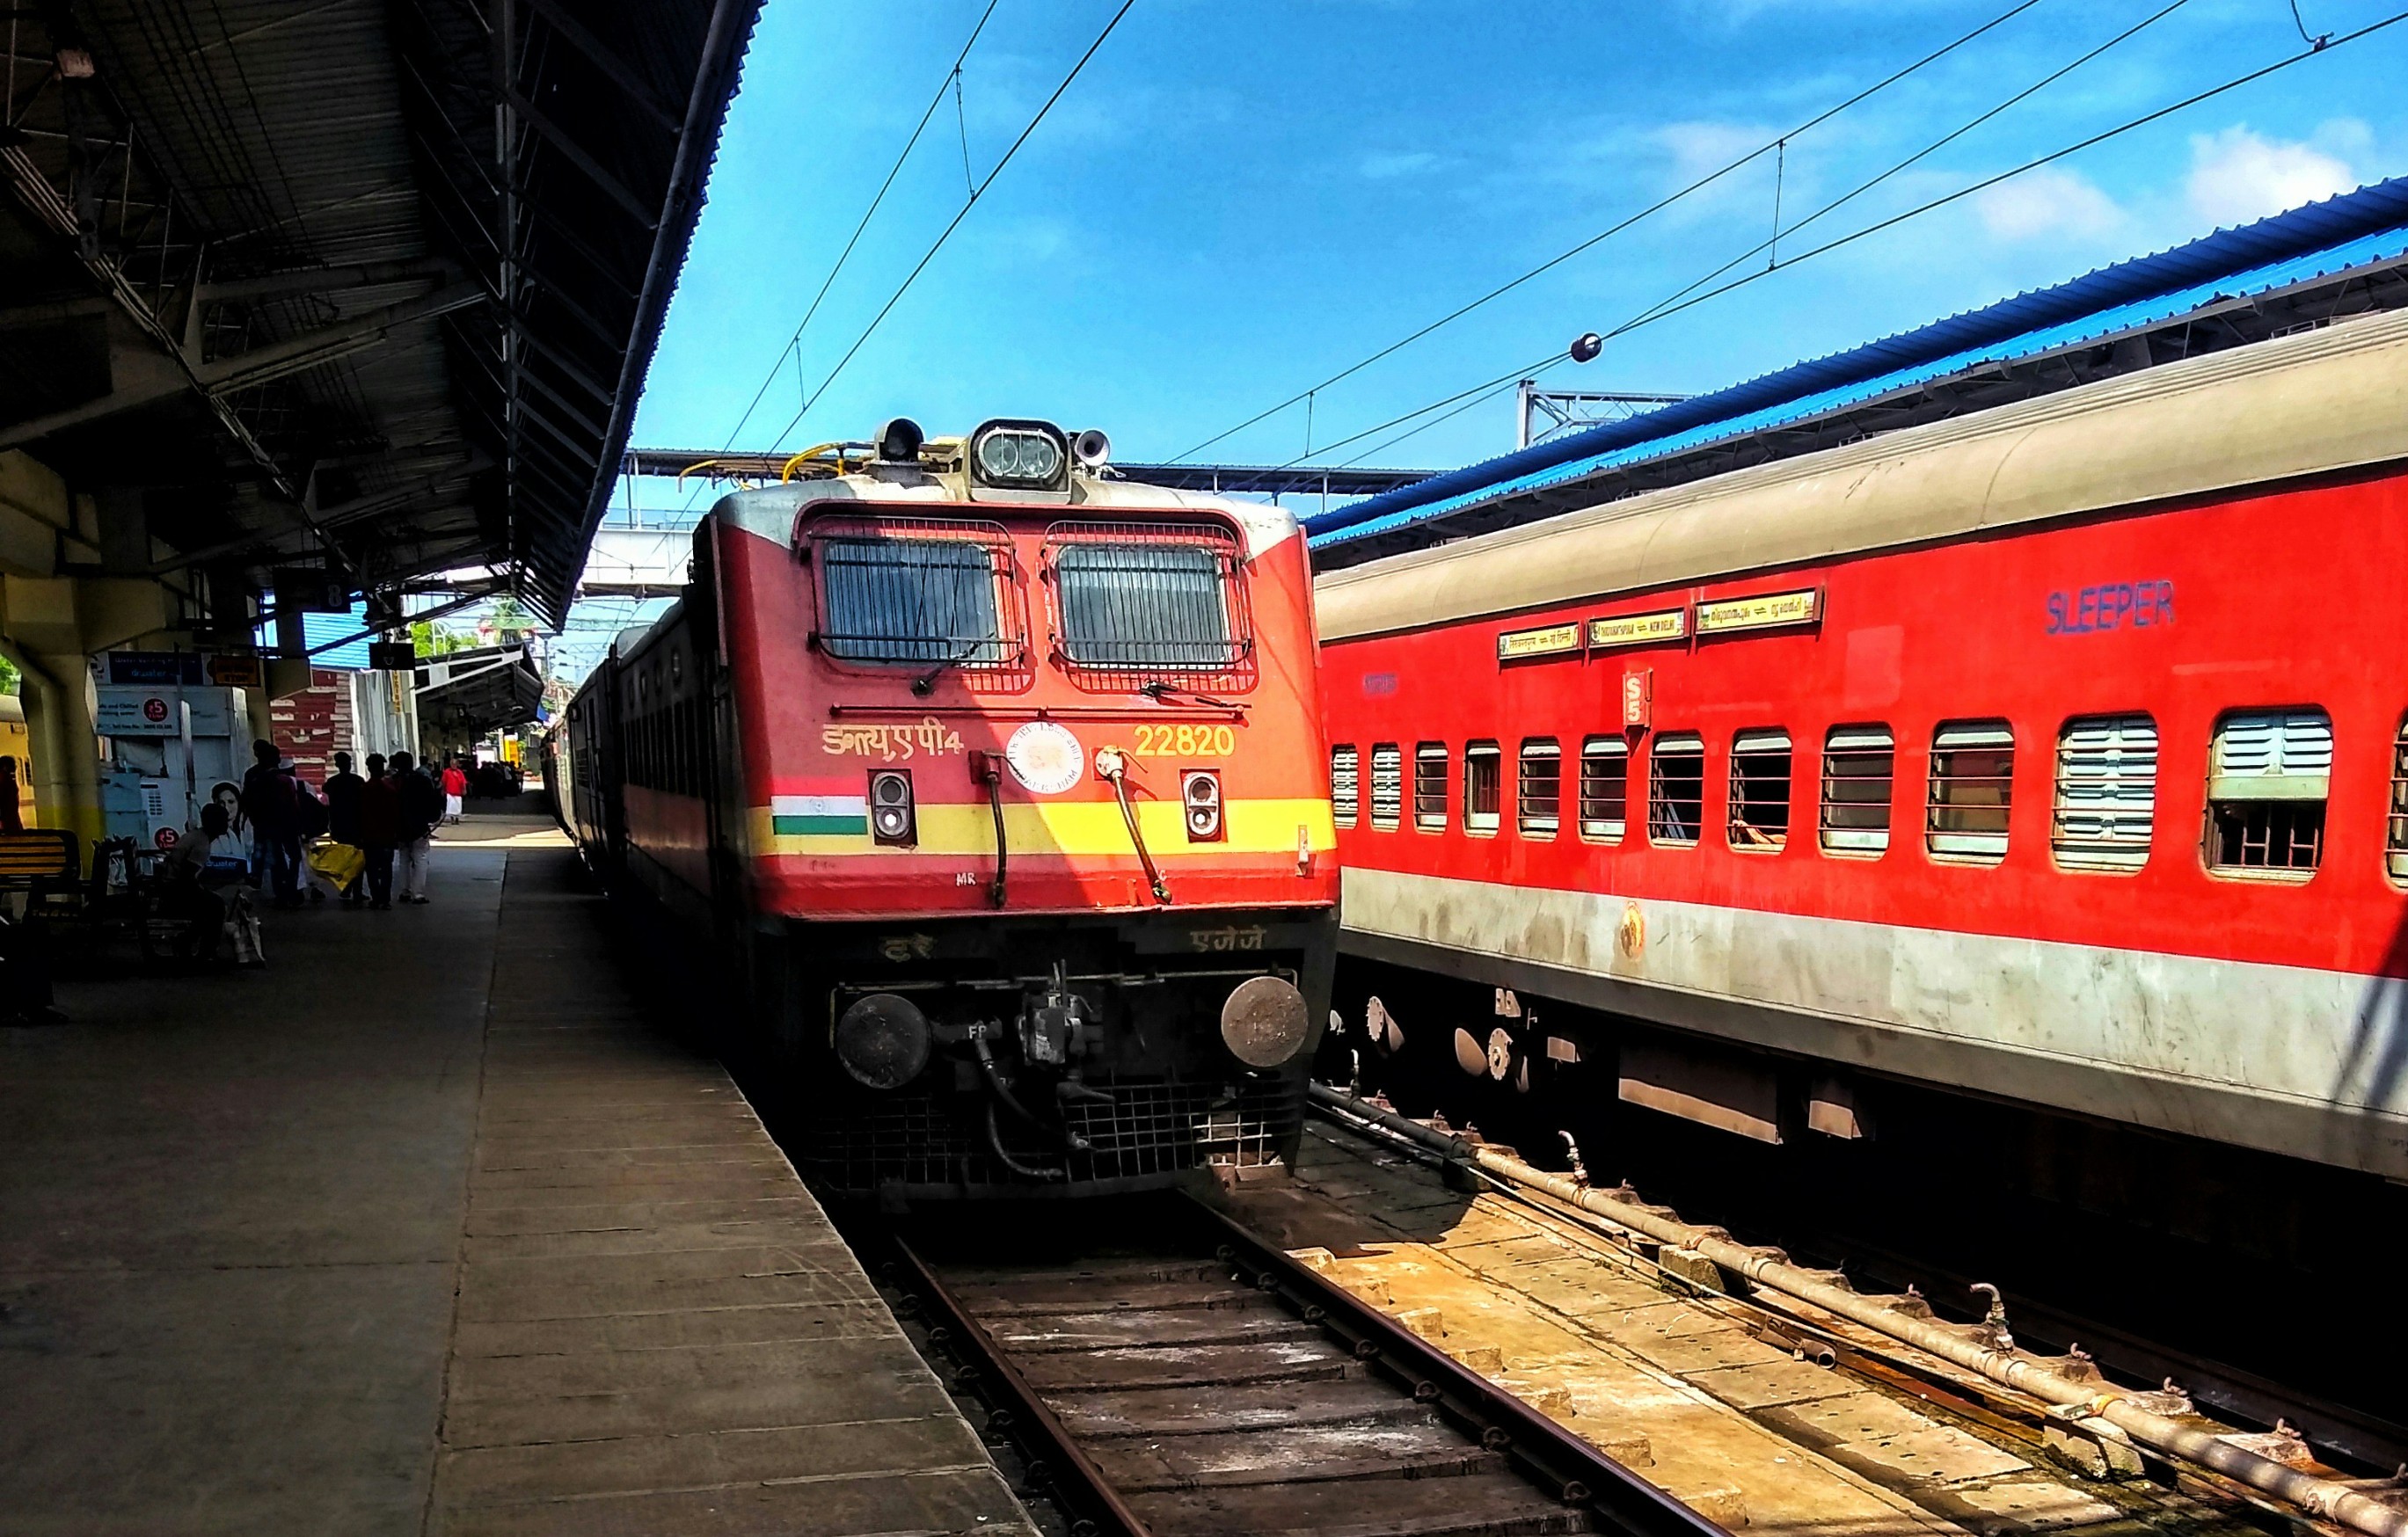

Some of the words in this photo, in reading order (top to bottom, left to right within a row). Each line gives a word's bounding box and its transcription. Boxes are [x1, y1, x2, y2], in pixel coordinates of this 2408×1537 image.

[327, 584, 343, 608] 8
[2047, 580, 2174, 634] SLEEPER
[1626, 676, 1642, 723] S5
[1134, 725, 1236, 757] 22820
[956, 872, 976, 886] MR
[969, 1025, 987, 1039] FP
